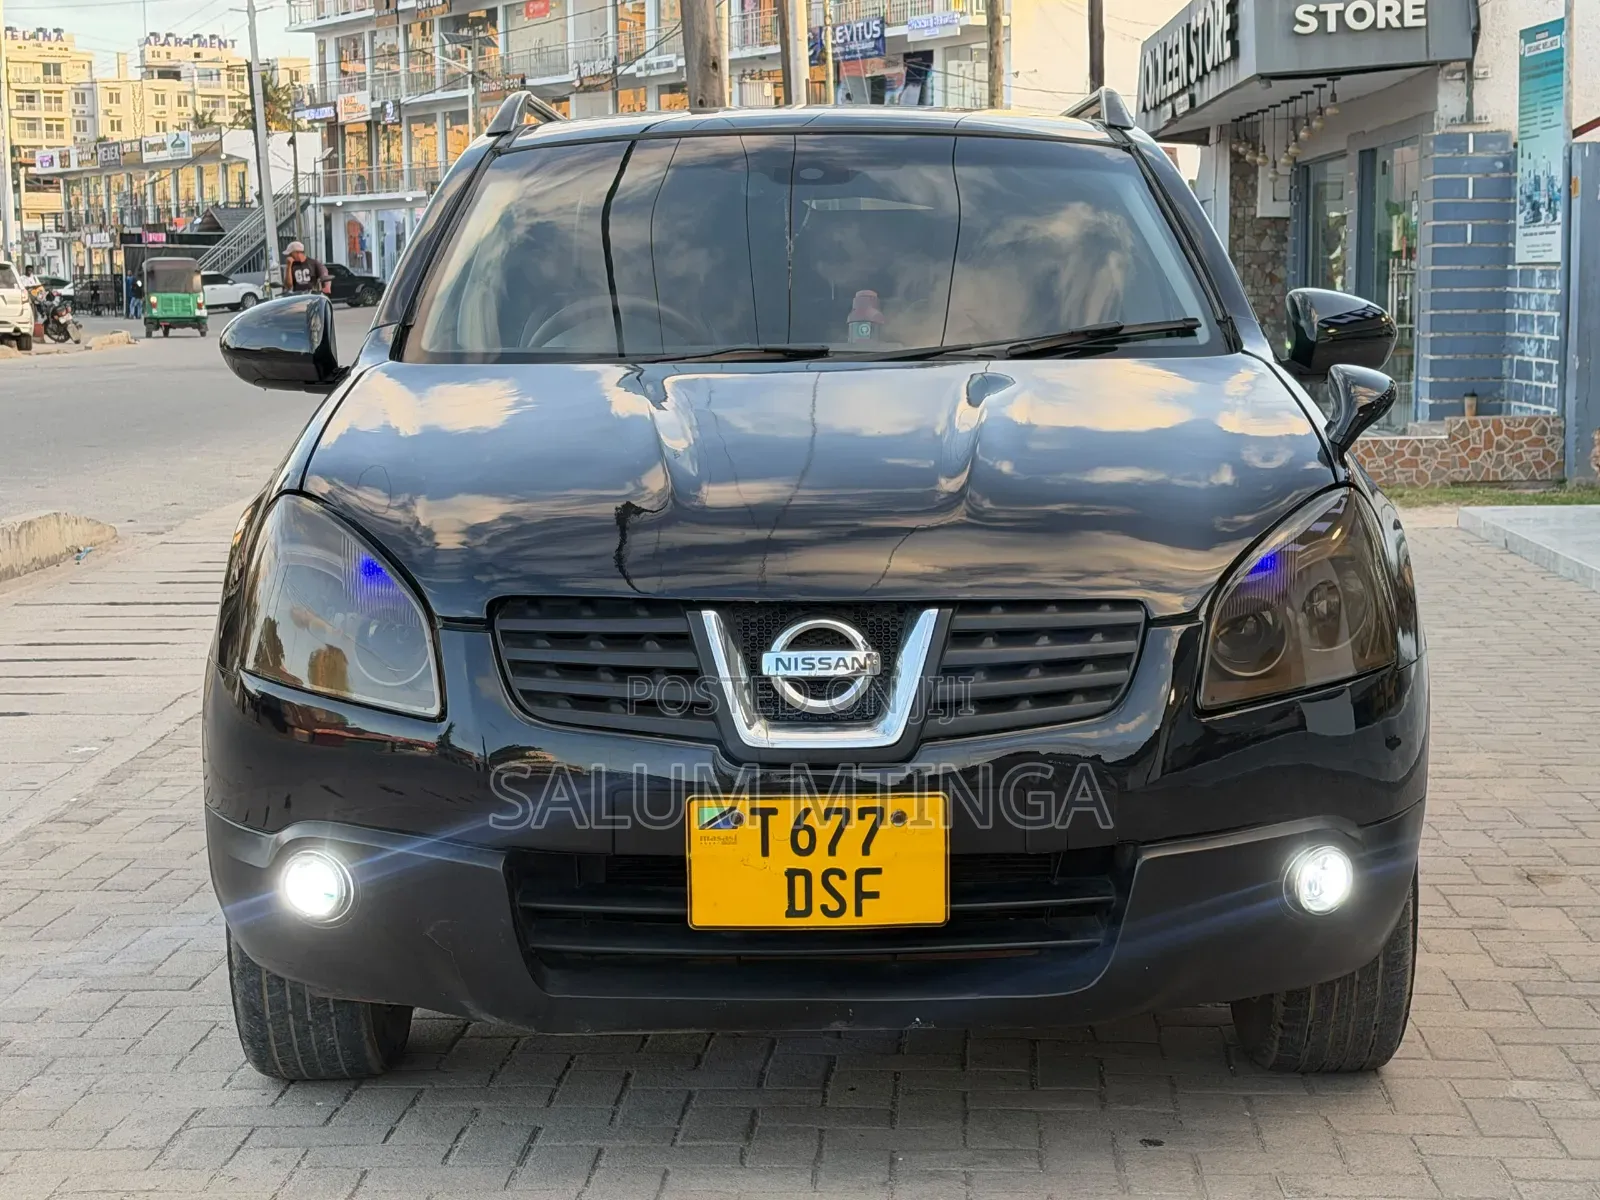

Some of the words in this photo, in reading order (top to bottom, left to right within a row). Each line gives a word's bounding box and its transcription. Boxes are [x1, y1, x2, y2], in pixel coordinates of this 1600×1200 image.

[1293, 0, 1427, 35] STORE
[144, 34, 238, 49] APARTMENT
[1190, 0, 1231, 84] STORE
[775, 657, 868, 671] NISSAN
[751, 807, 778, 857] T
[790, 807, 884, 857] 677
[785, 868, 883, 919] DSF
